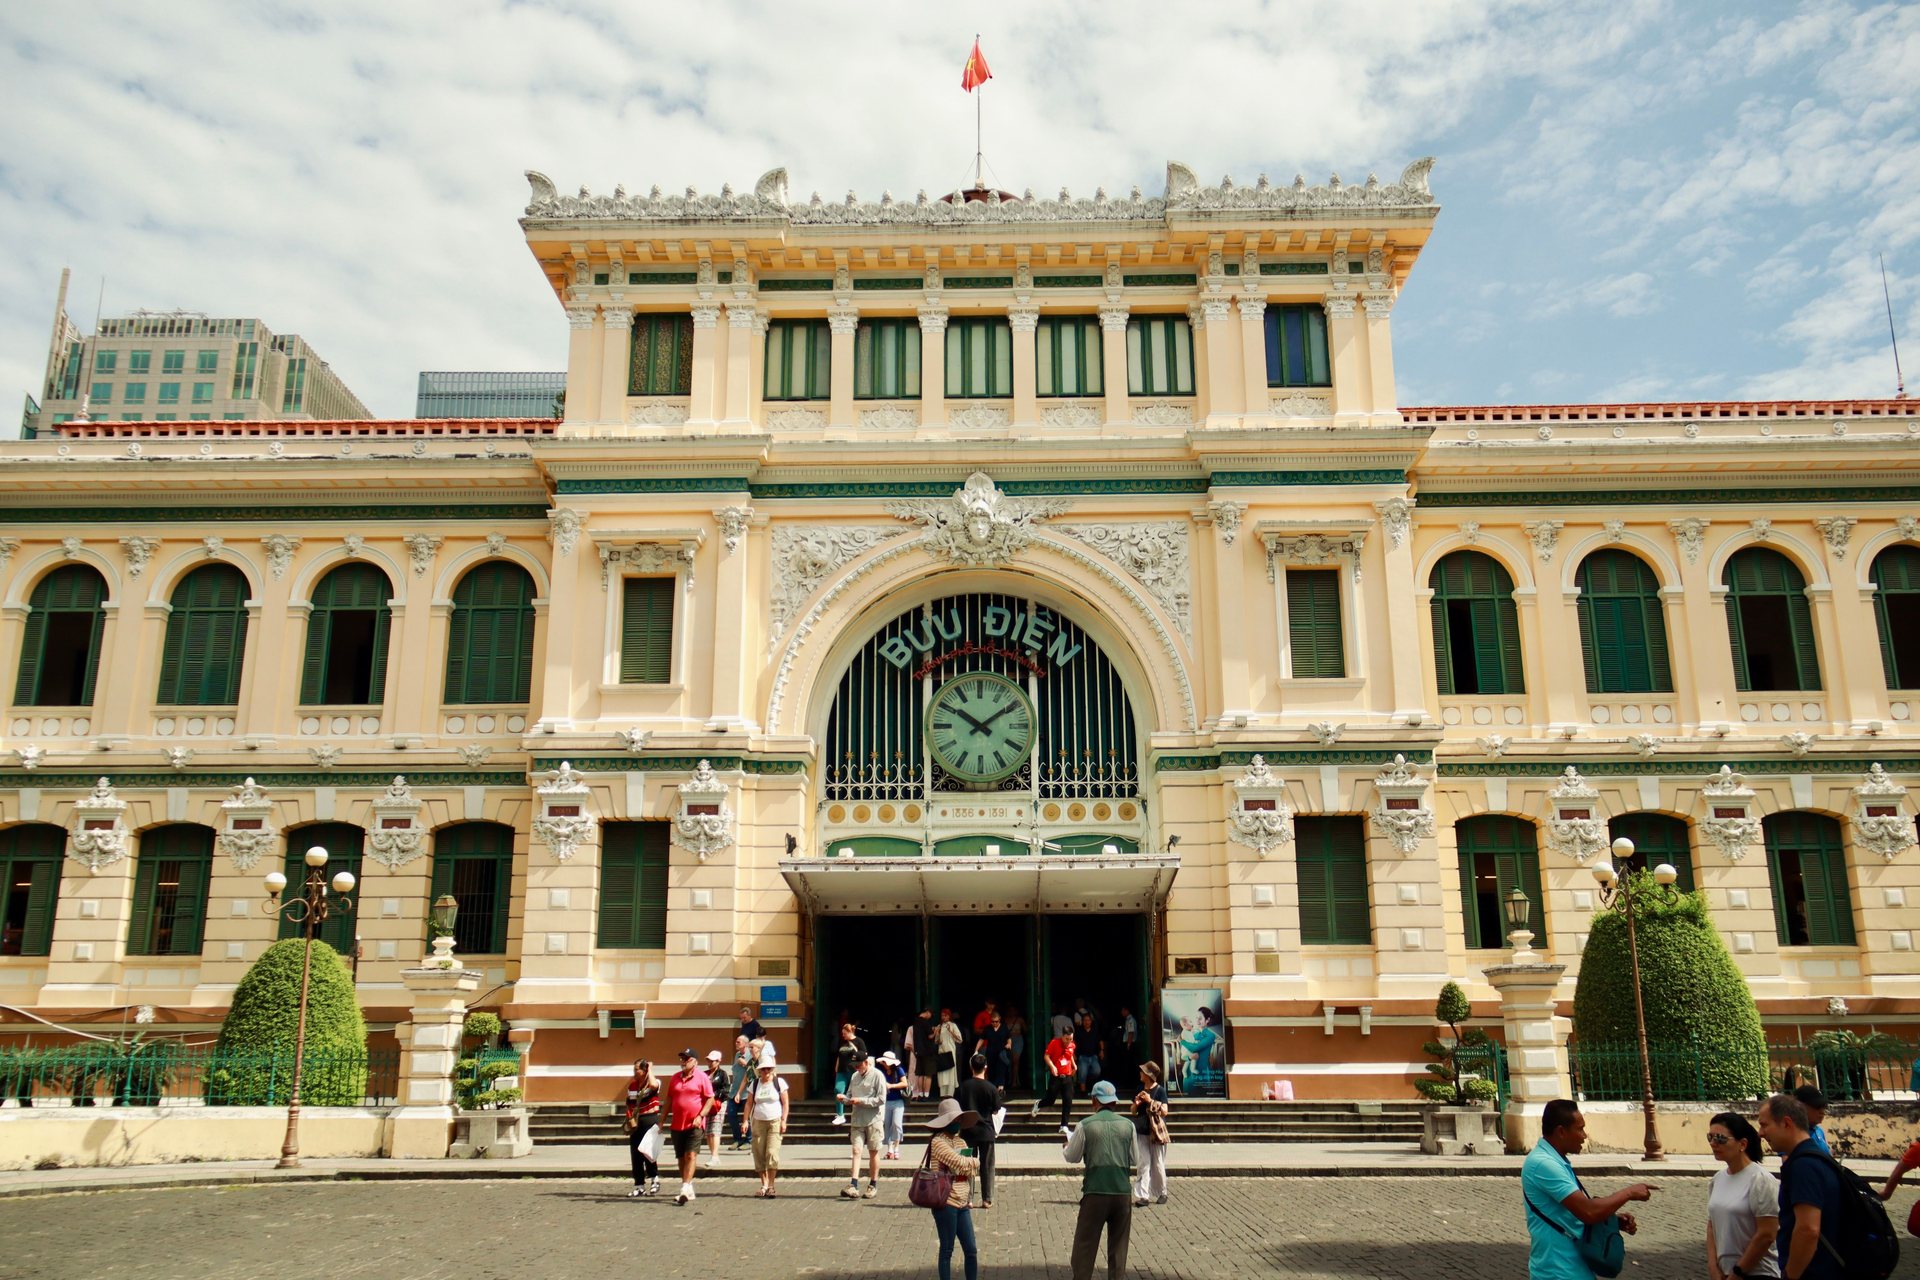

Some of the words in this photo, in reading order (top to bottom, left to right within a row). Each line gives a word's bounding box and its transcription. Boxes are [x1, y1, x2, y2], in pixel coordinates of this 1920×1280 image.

[982, 605, 1082, 668] ĐIỆN
[952, 807, 974, 818] 1886
[988, 807, 1008, 818] 1891
